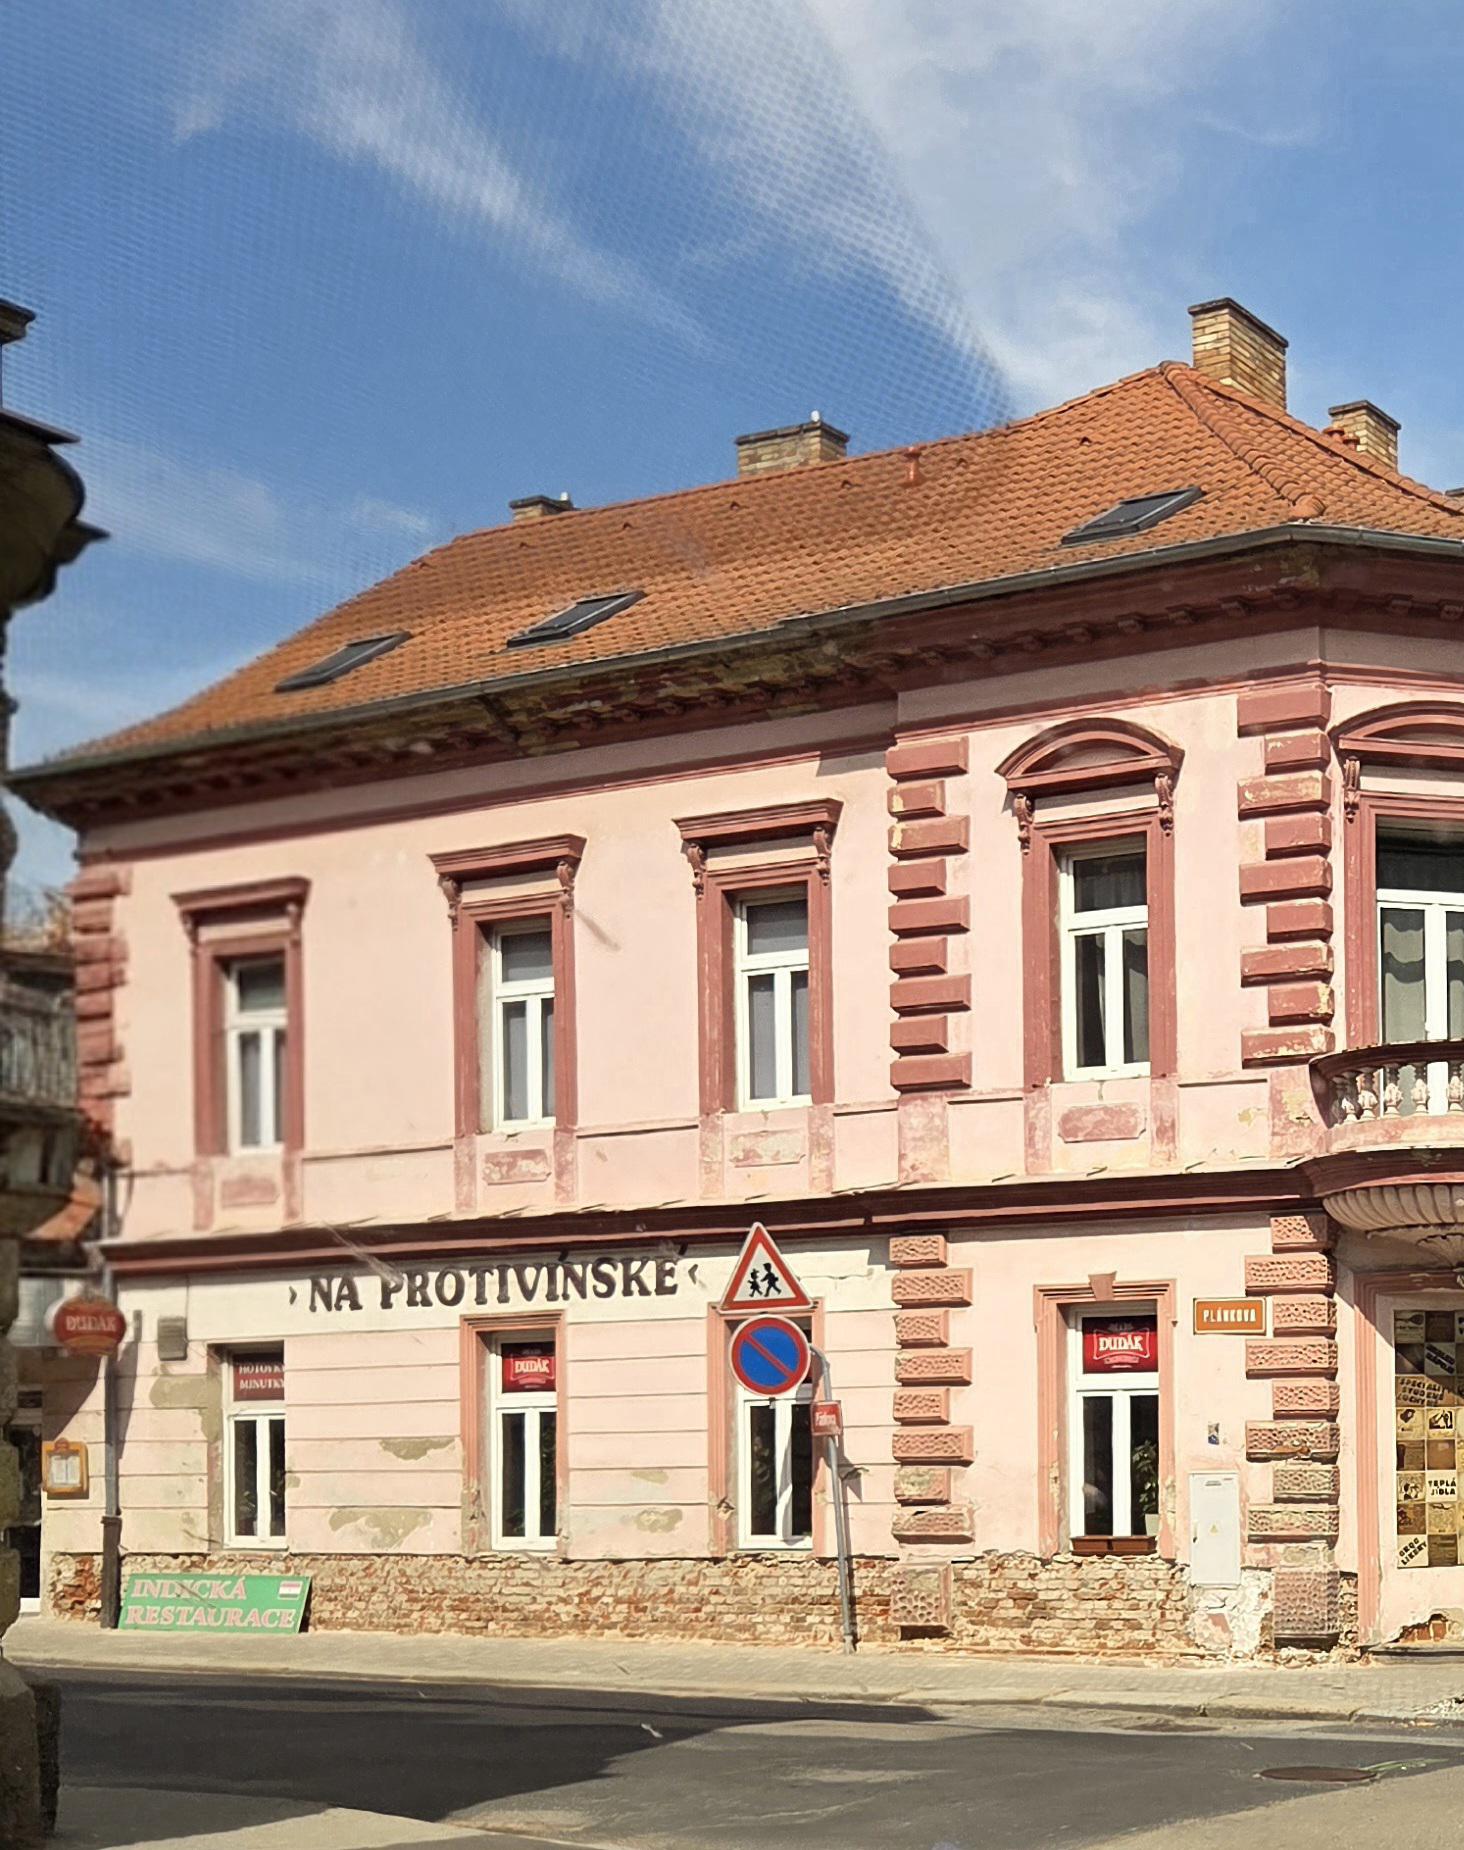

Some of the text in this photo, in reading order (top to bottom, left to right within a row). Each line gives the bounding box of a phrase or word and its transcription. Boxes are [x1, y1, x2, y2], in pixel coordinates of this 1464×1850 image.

[309, 1274, 362, 1312] NA
[1098, 1334, 1144, 1352] DUDÁK
[131, 1575, 247, 1601] INDICKÁ
[125, 1605, 298, 1629] RESTAURACE
